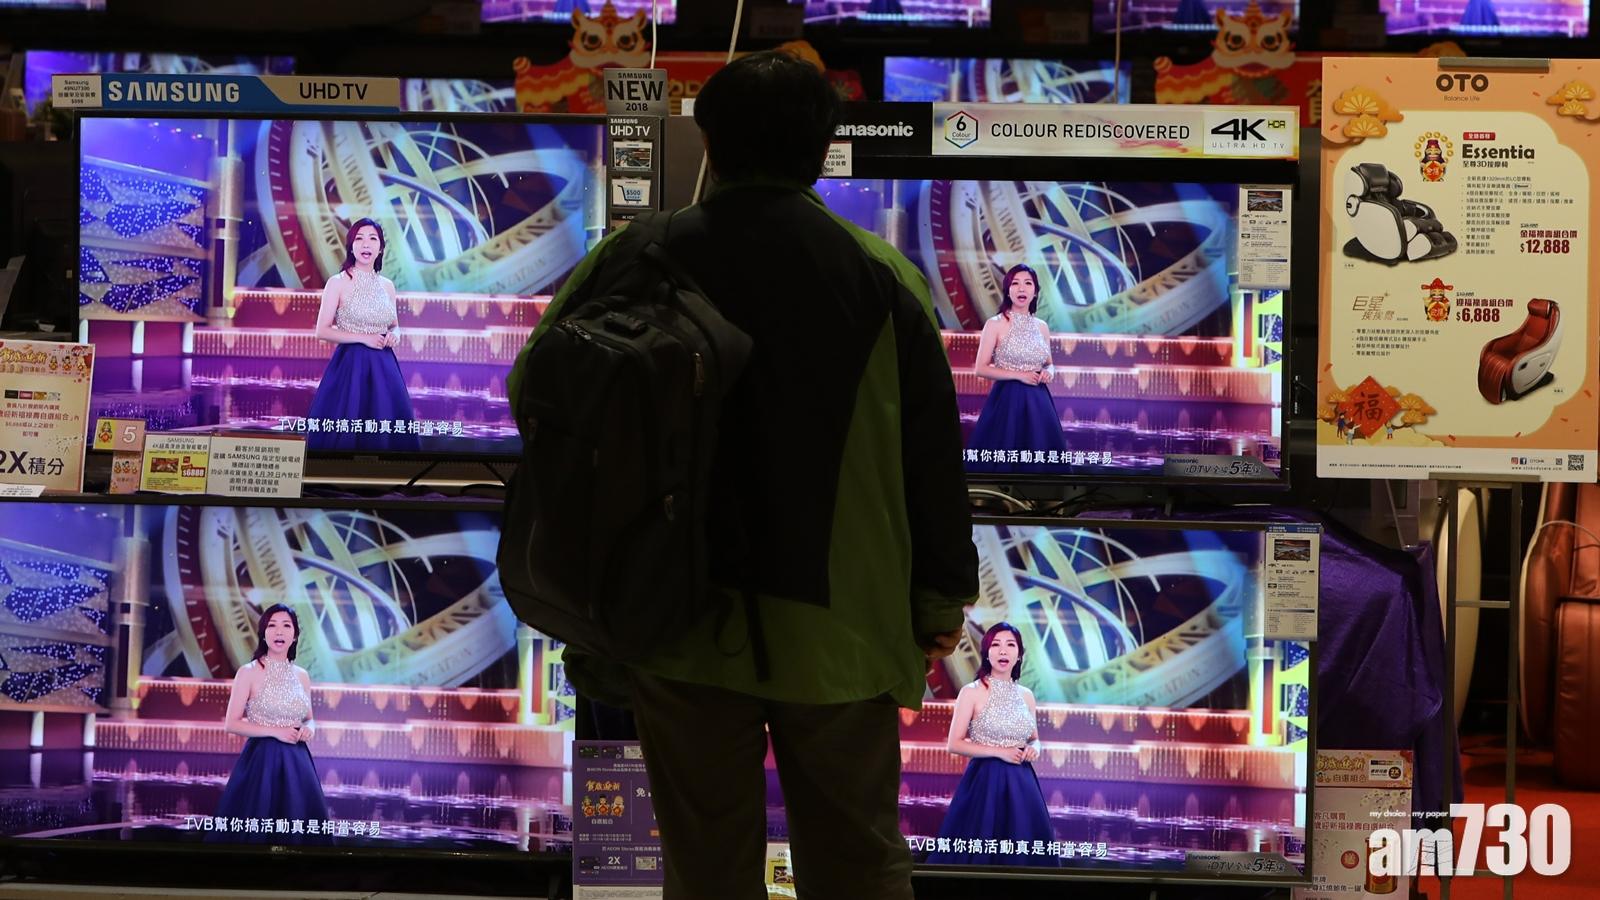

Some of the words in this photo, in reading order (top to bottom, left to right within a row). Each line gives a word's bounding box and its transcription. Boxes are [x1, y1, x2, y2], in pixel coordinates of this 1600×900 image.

[108, 80, 240, 102] SAMSUNG
[300, 82, 341, 100] UHD
[346, 84, 368, 100] TV
[608, 80, 664, 101] NEW
[1436, 74, 1489, 92] OTO
[625, 103, 648, 112] 2018
[610, 126, 634, 136] UHD
[635, 126, 650, 136] TV
[834, 122, 914, 136] anasonic
[956, 116, 966, 131] 6
[1210, 118, 1268, 141] 4K
[1268, 120, 1286, 128] HDR
[990, 124, 1058, 138] COLOUR
[1062, 124, 1190, 140] REDISCOVERED
[1462, 143, 1535, 159] Essentia
[1520, 239, 1570, 254] $12,888
[1352, 296, 1384, 311] 巨星
[1456, 308, 1500, 323] $6,888
[1353, 392, 1384, 421] 福
[123, 426, 136, 443] 5
[963, 448, 1113, 465] 幫你搞活動真是相當容易
[184, 817, 381, 836] TVB幫你搞活動真是相當容易
